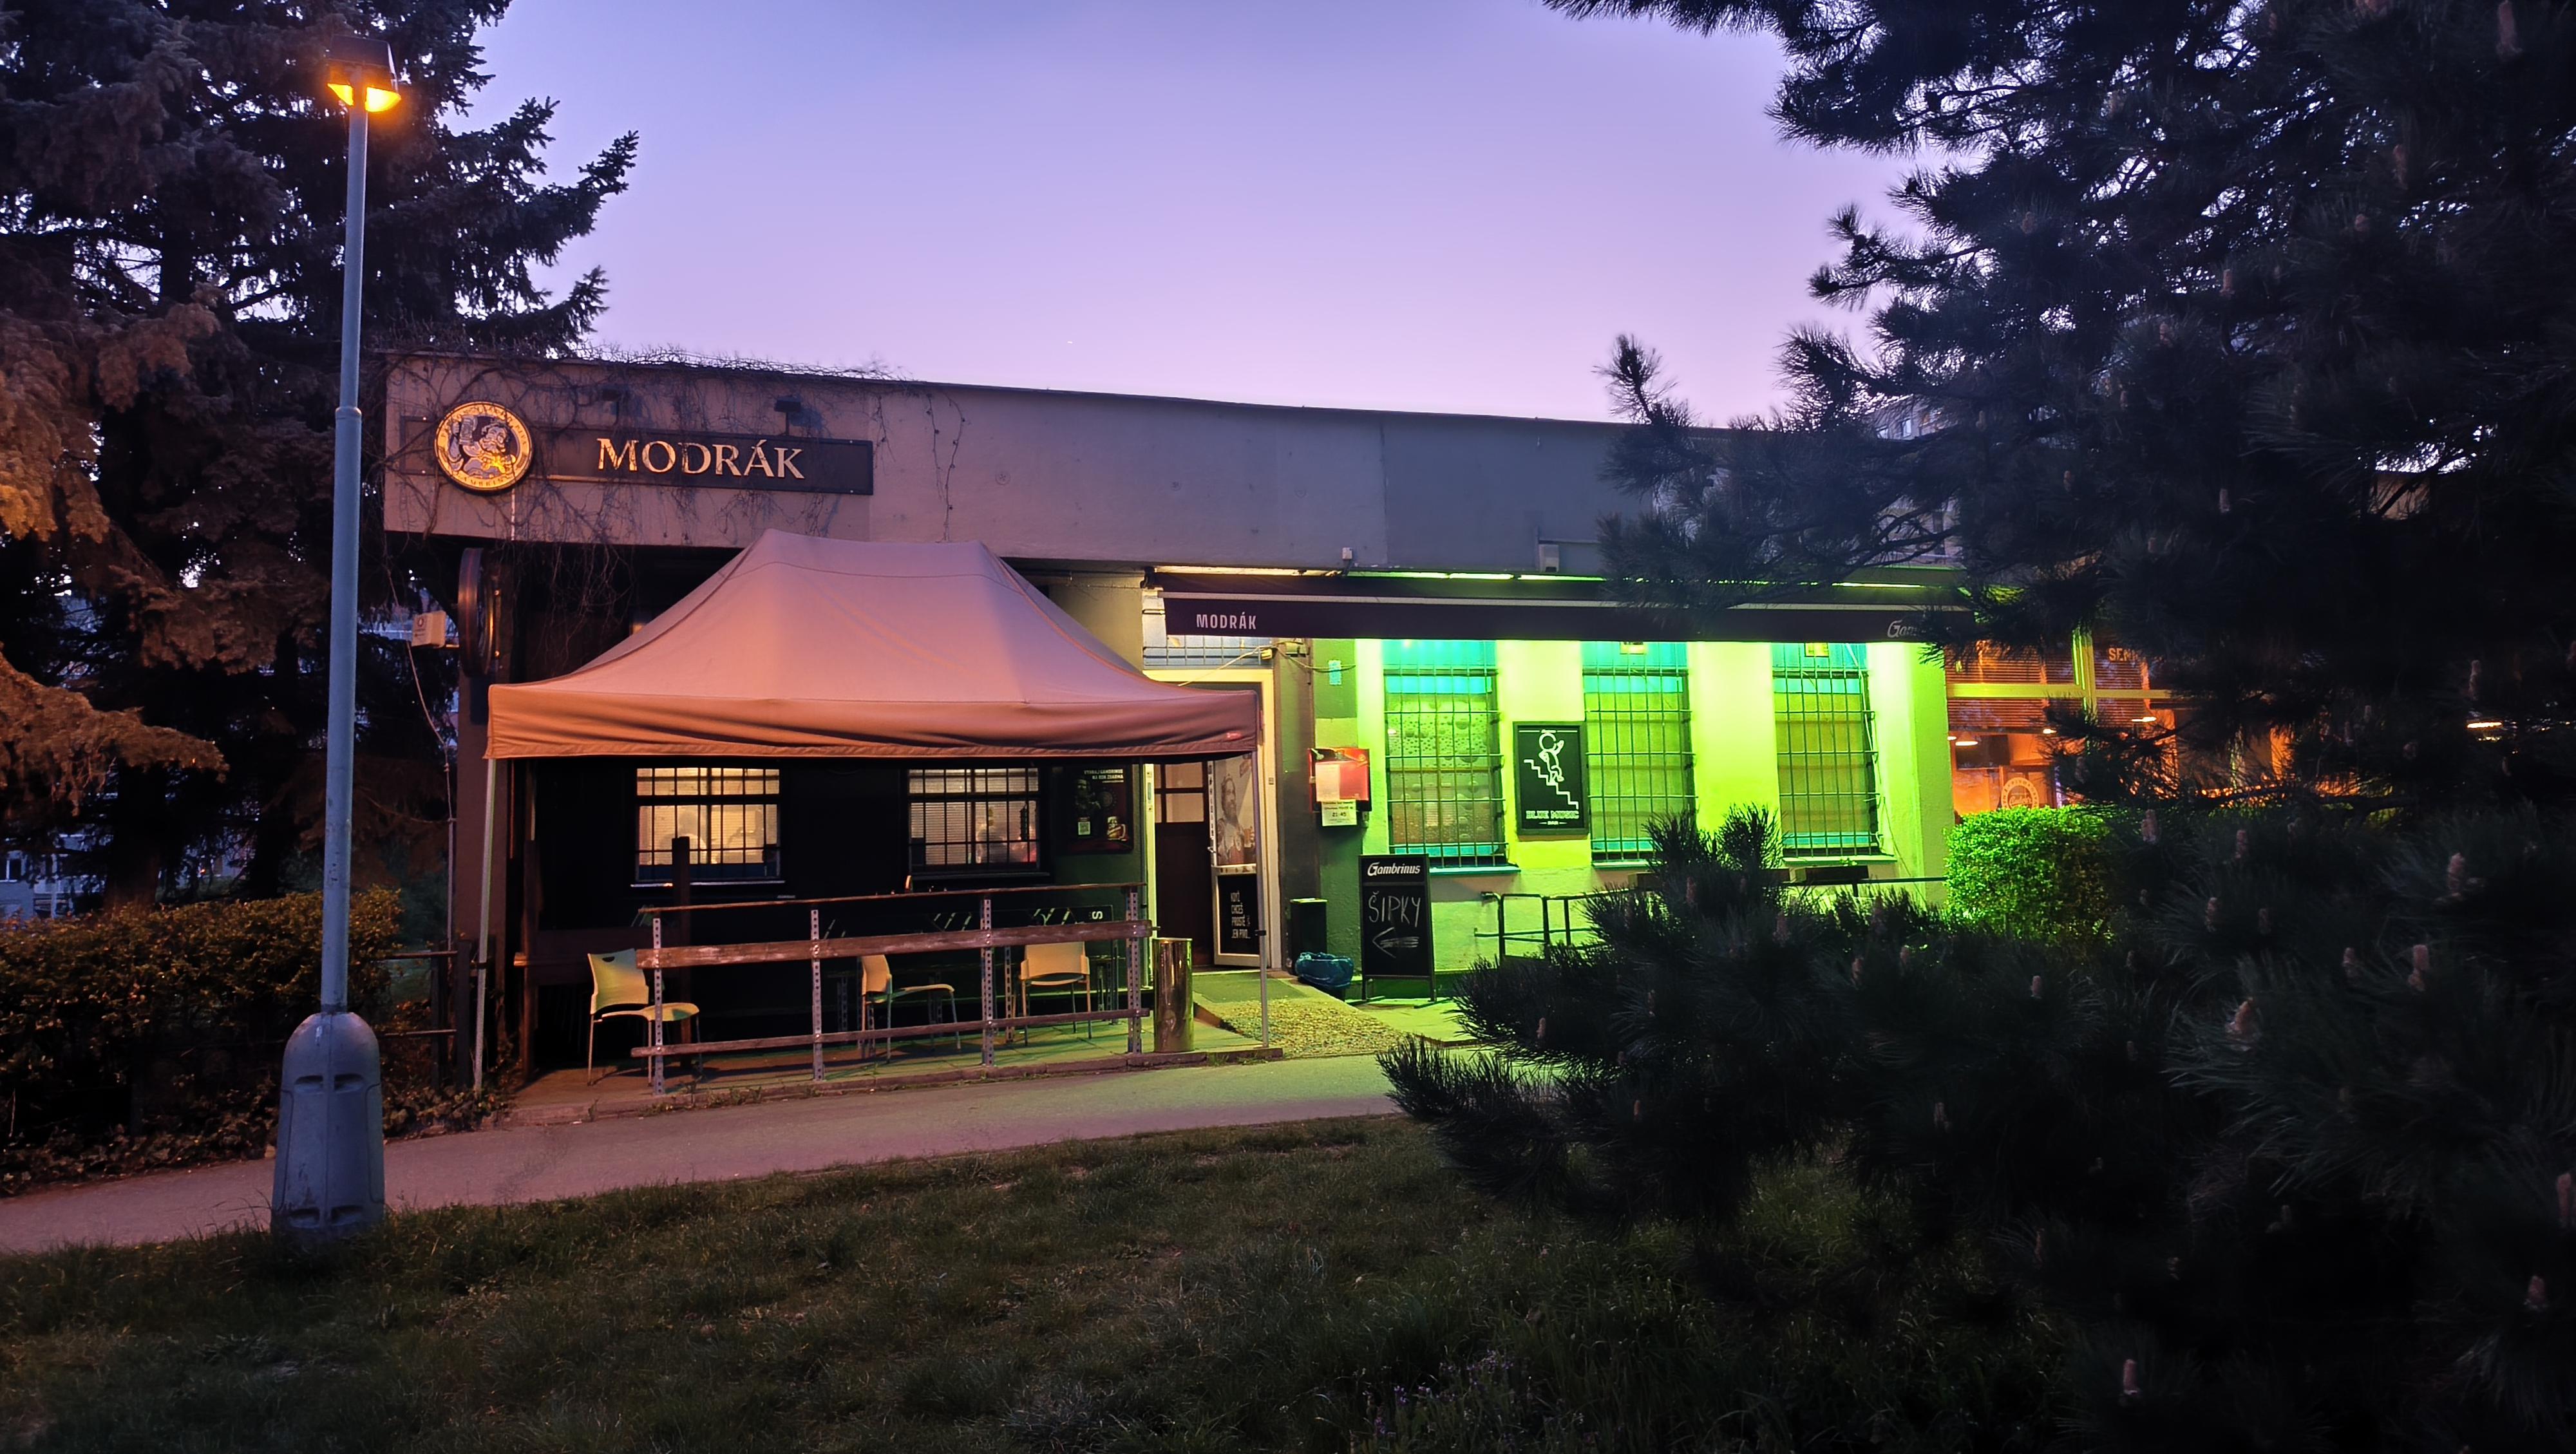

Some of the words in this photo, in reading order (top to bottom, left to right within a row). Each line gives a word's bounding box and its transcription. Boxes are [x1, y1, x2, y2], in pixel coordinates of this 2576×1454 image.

[597, 438, 805, 479] MODRÁK
[1197, 611, 1256, 630] MODRÁK
[1526, 810, 1549, 819] BLUE
[1550, 810, 1579, 819] MUSIC
[1367, 862, 1421, 876] Gambrinus
[1231, 902, 1244, 914] CHCEŠ
[1368, 891, 1421, 927] ŠIPKY
